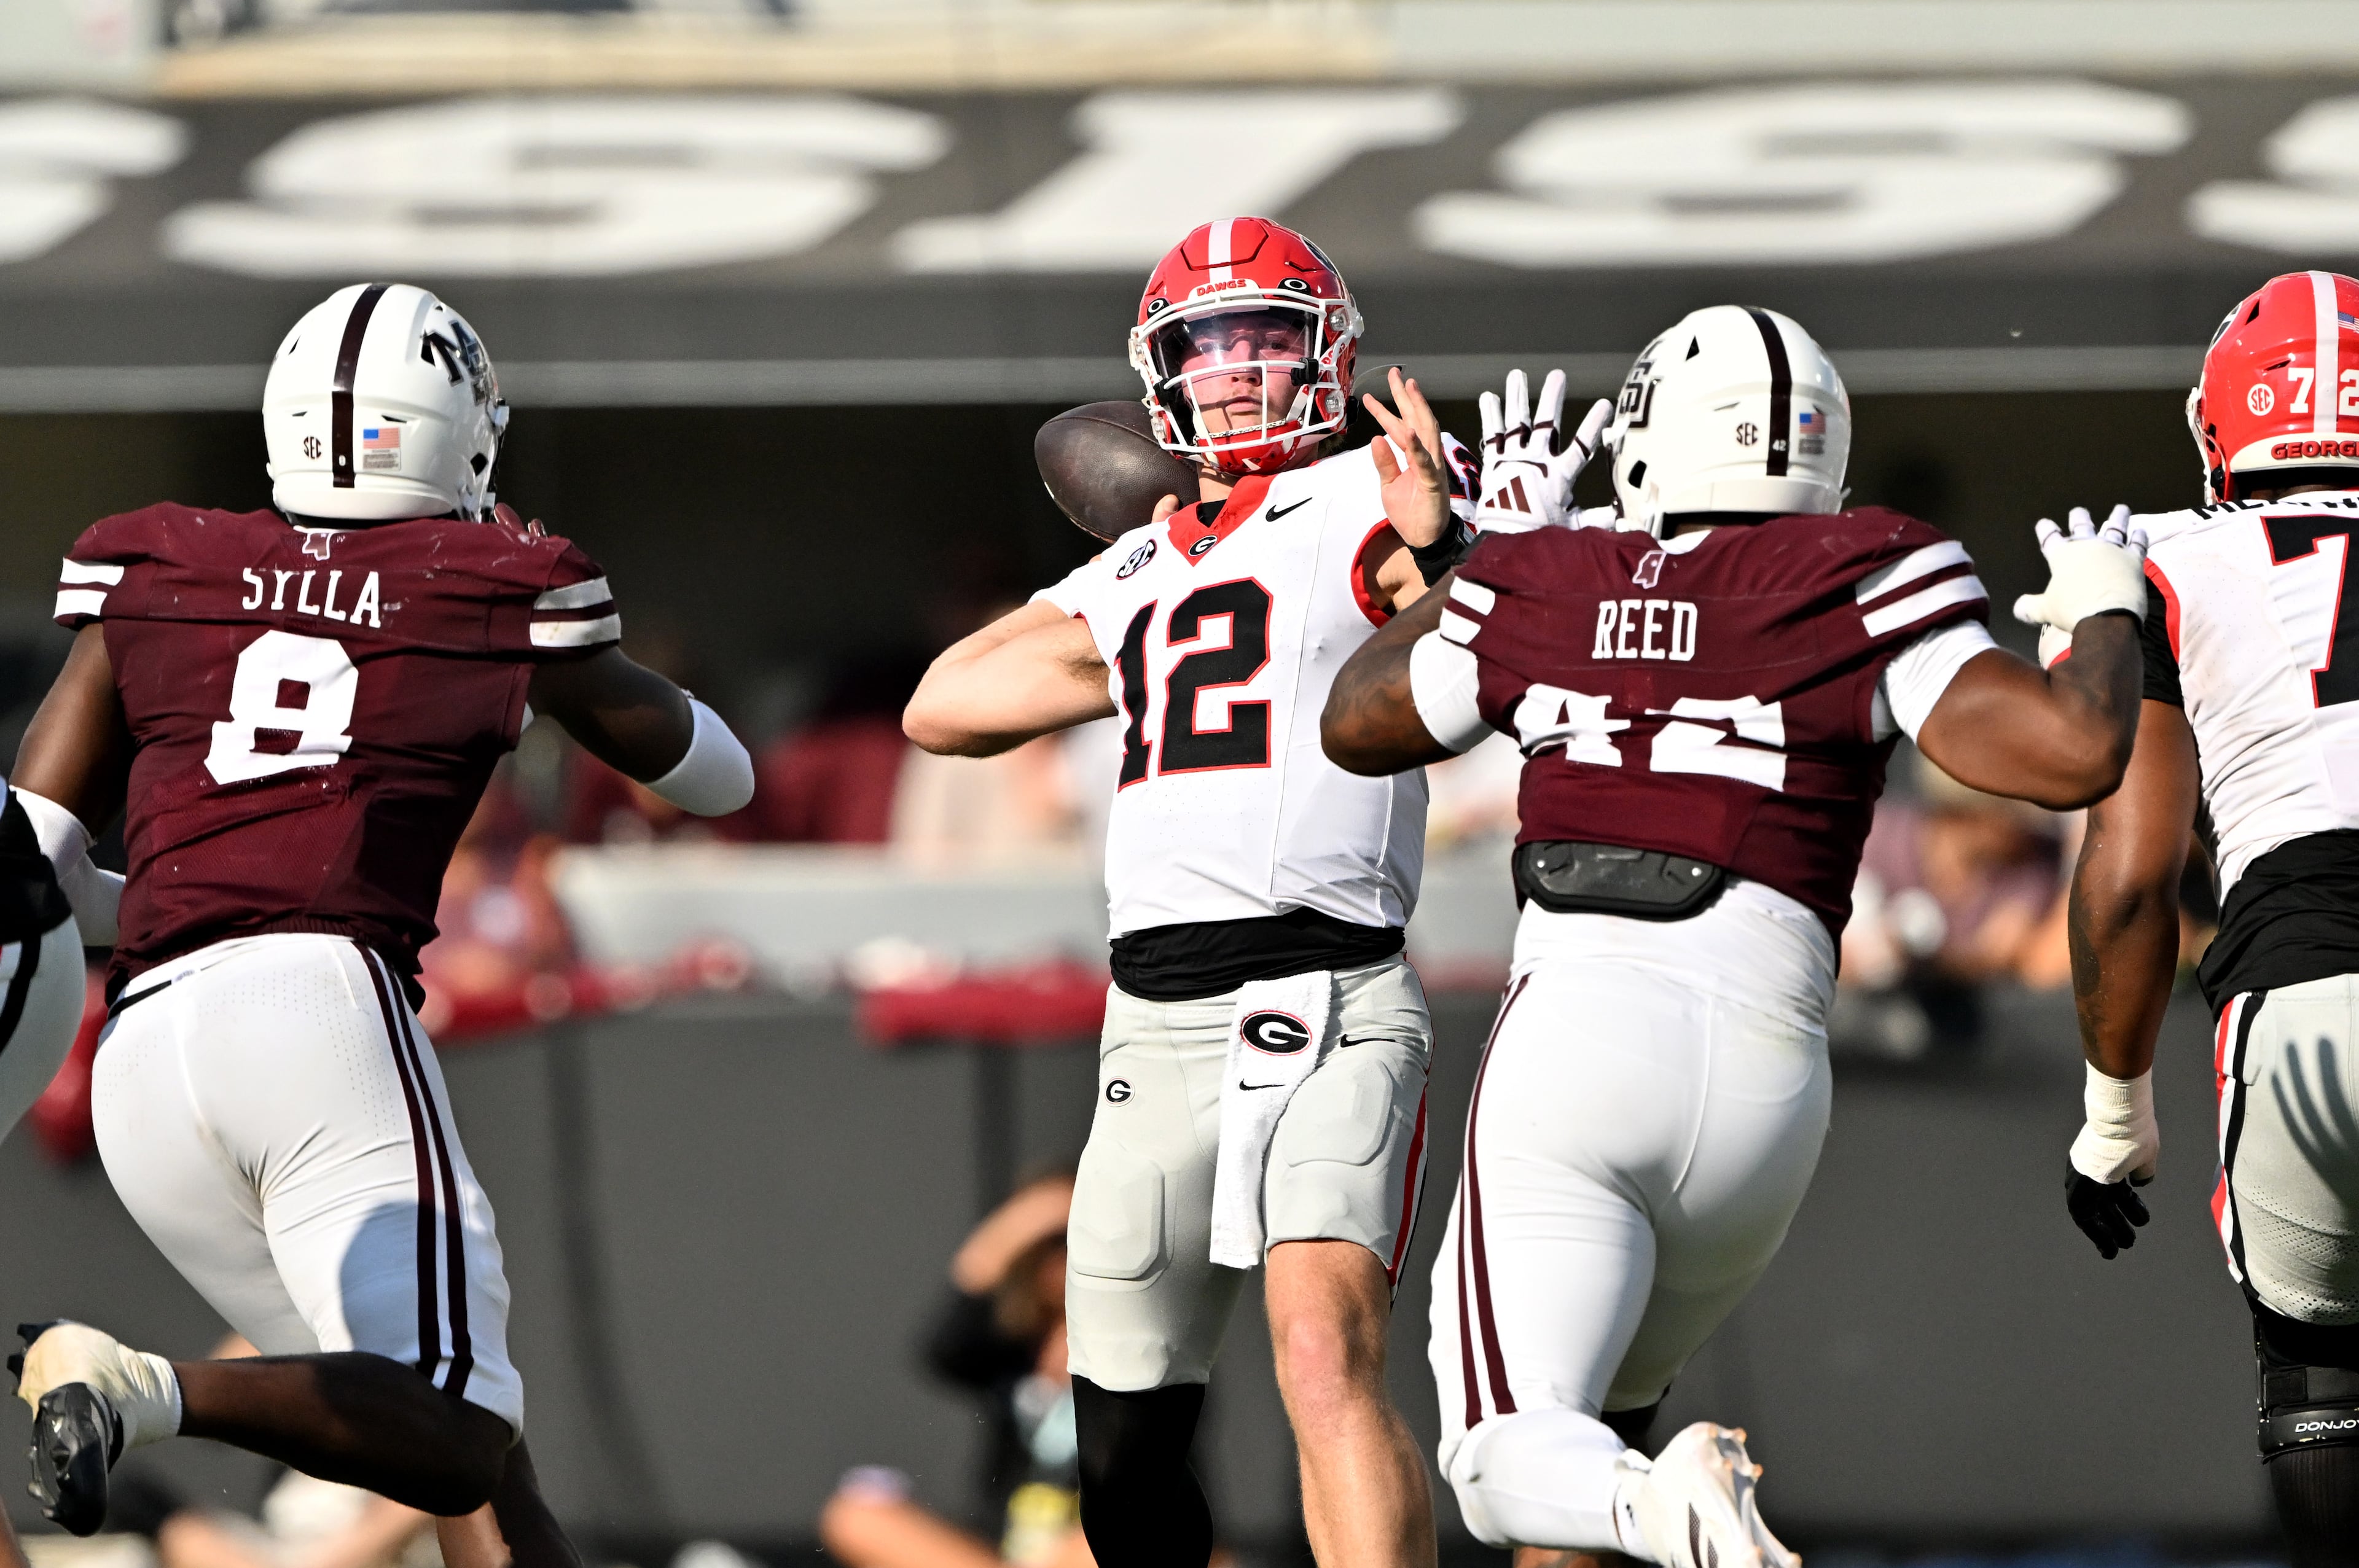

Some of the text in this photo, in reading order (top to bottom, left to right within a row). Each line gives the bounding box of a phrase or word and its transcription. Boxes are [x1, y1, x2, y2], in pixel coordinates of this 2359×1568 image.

[1197, 279, 1246, 296] DAWGS
[2251, 388, 2271, 412] SEC
[1736, 423, 1758, 445] SEC
[1772, 439, 1787, 451] 42
[303, 436, 321, 459] SEC
[1189, 535, 1218, 556] G
[242, 567, 381, 628] SYLLA
[1592, 599, 1697, 661] REED
[1115, 576, 1274, 793] 12
[204, 630, 359, 785] 8
[1514, 683, 1787, 792] 42
[1240, 1011, 1312, 1056] G
[1106, 1079, 1132, 1103] G
